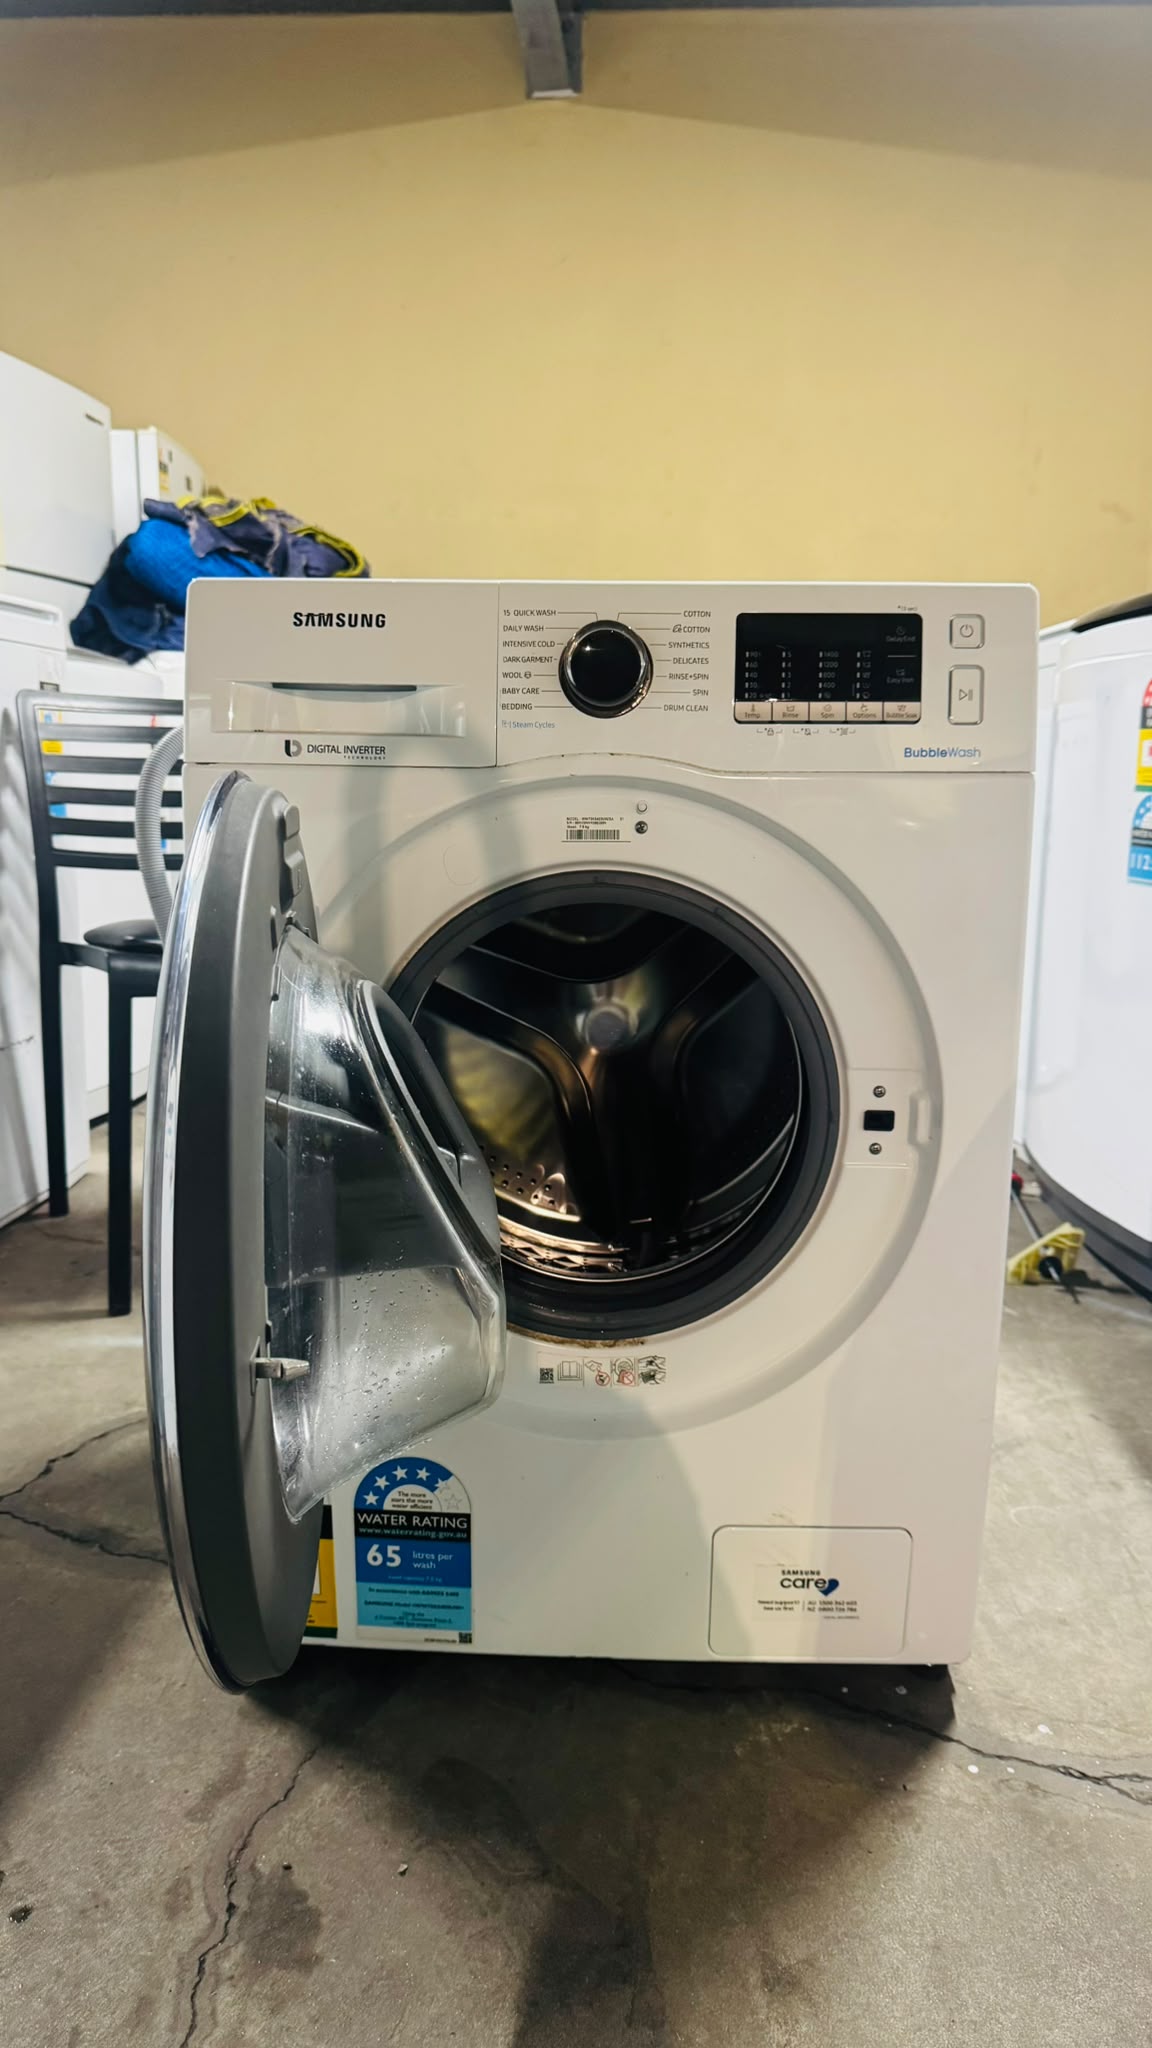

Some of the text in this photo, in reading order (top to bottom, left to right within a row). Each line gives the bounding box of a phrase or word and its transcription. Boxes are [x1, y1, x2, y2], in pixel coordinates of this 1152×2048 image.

[503, 609, 557, 617] 15 QUICK WASH
[683, 610, 711, 618] COTTON
[293, 612, 386, 628] SAMSUNG
[502, 624, 544, 632] DAILY WASH
[682, 626, 710, 634] COTTON
[502, 640, 556, 648] INTENSIVE COLD
[668, 641, 710, 649] SYNTHETICS
[502, 656, 553, 664] DARK GARMENT
[672, 657, 709, 665] DELICATES
[502, 671, 523, 679] WOOL
[501, 687, 540, 695] BABY CARE
[501, 703, 533, 711] BEDDING
[663, 704, 709, 712] DRUM CLEAN
[512, 721, 555, 730] Steam Cycles
[306, 744, 386, 755] DIGITAL INVERTER
[904, 747, 981, 758] BubbleWash
[357, 1512, 468, 1529] WATER RATING
[358, 1527, 468, 1539] www.waterrating.gov.au
[366, 1543, 402, 1568] 65
[412, 1551, 454, 1562] litres per
[412, 1560, 437, 1569] wash
[780, 1577, 827, 1589] care
